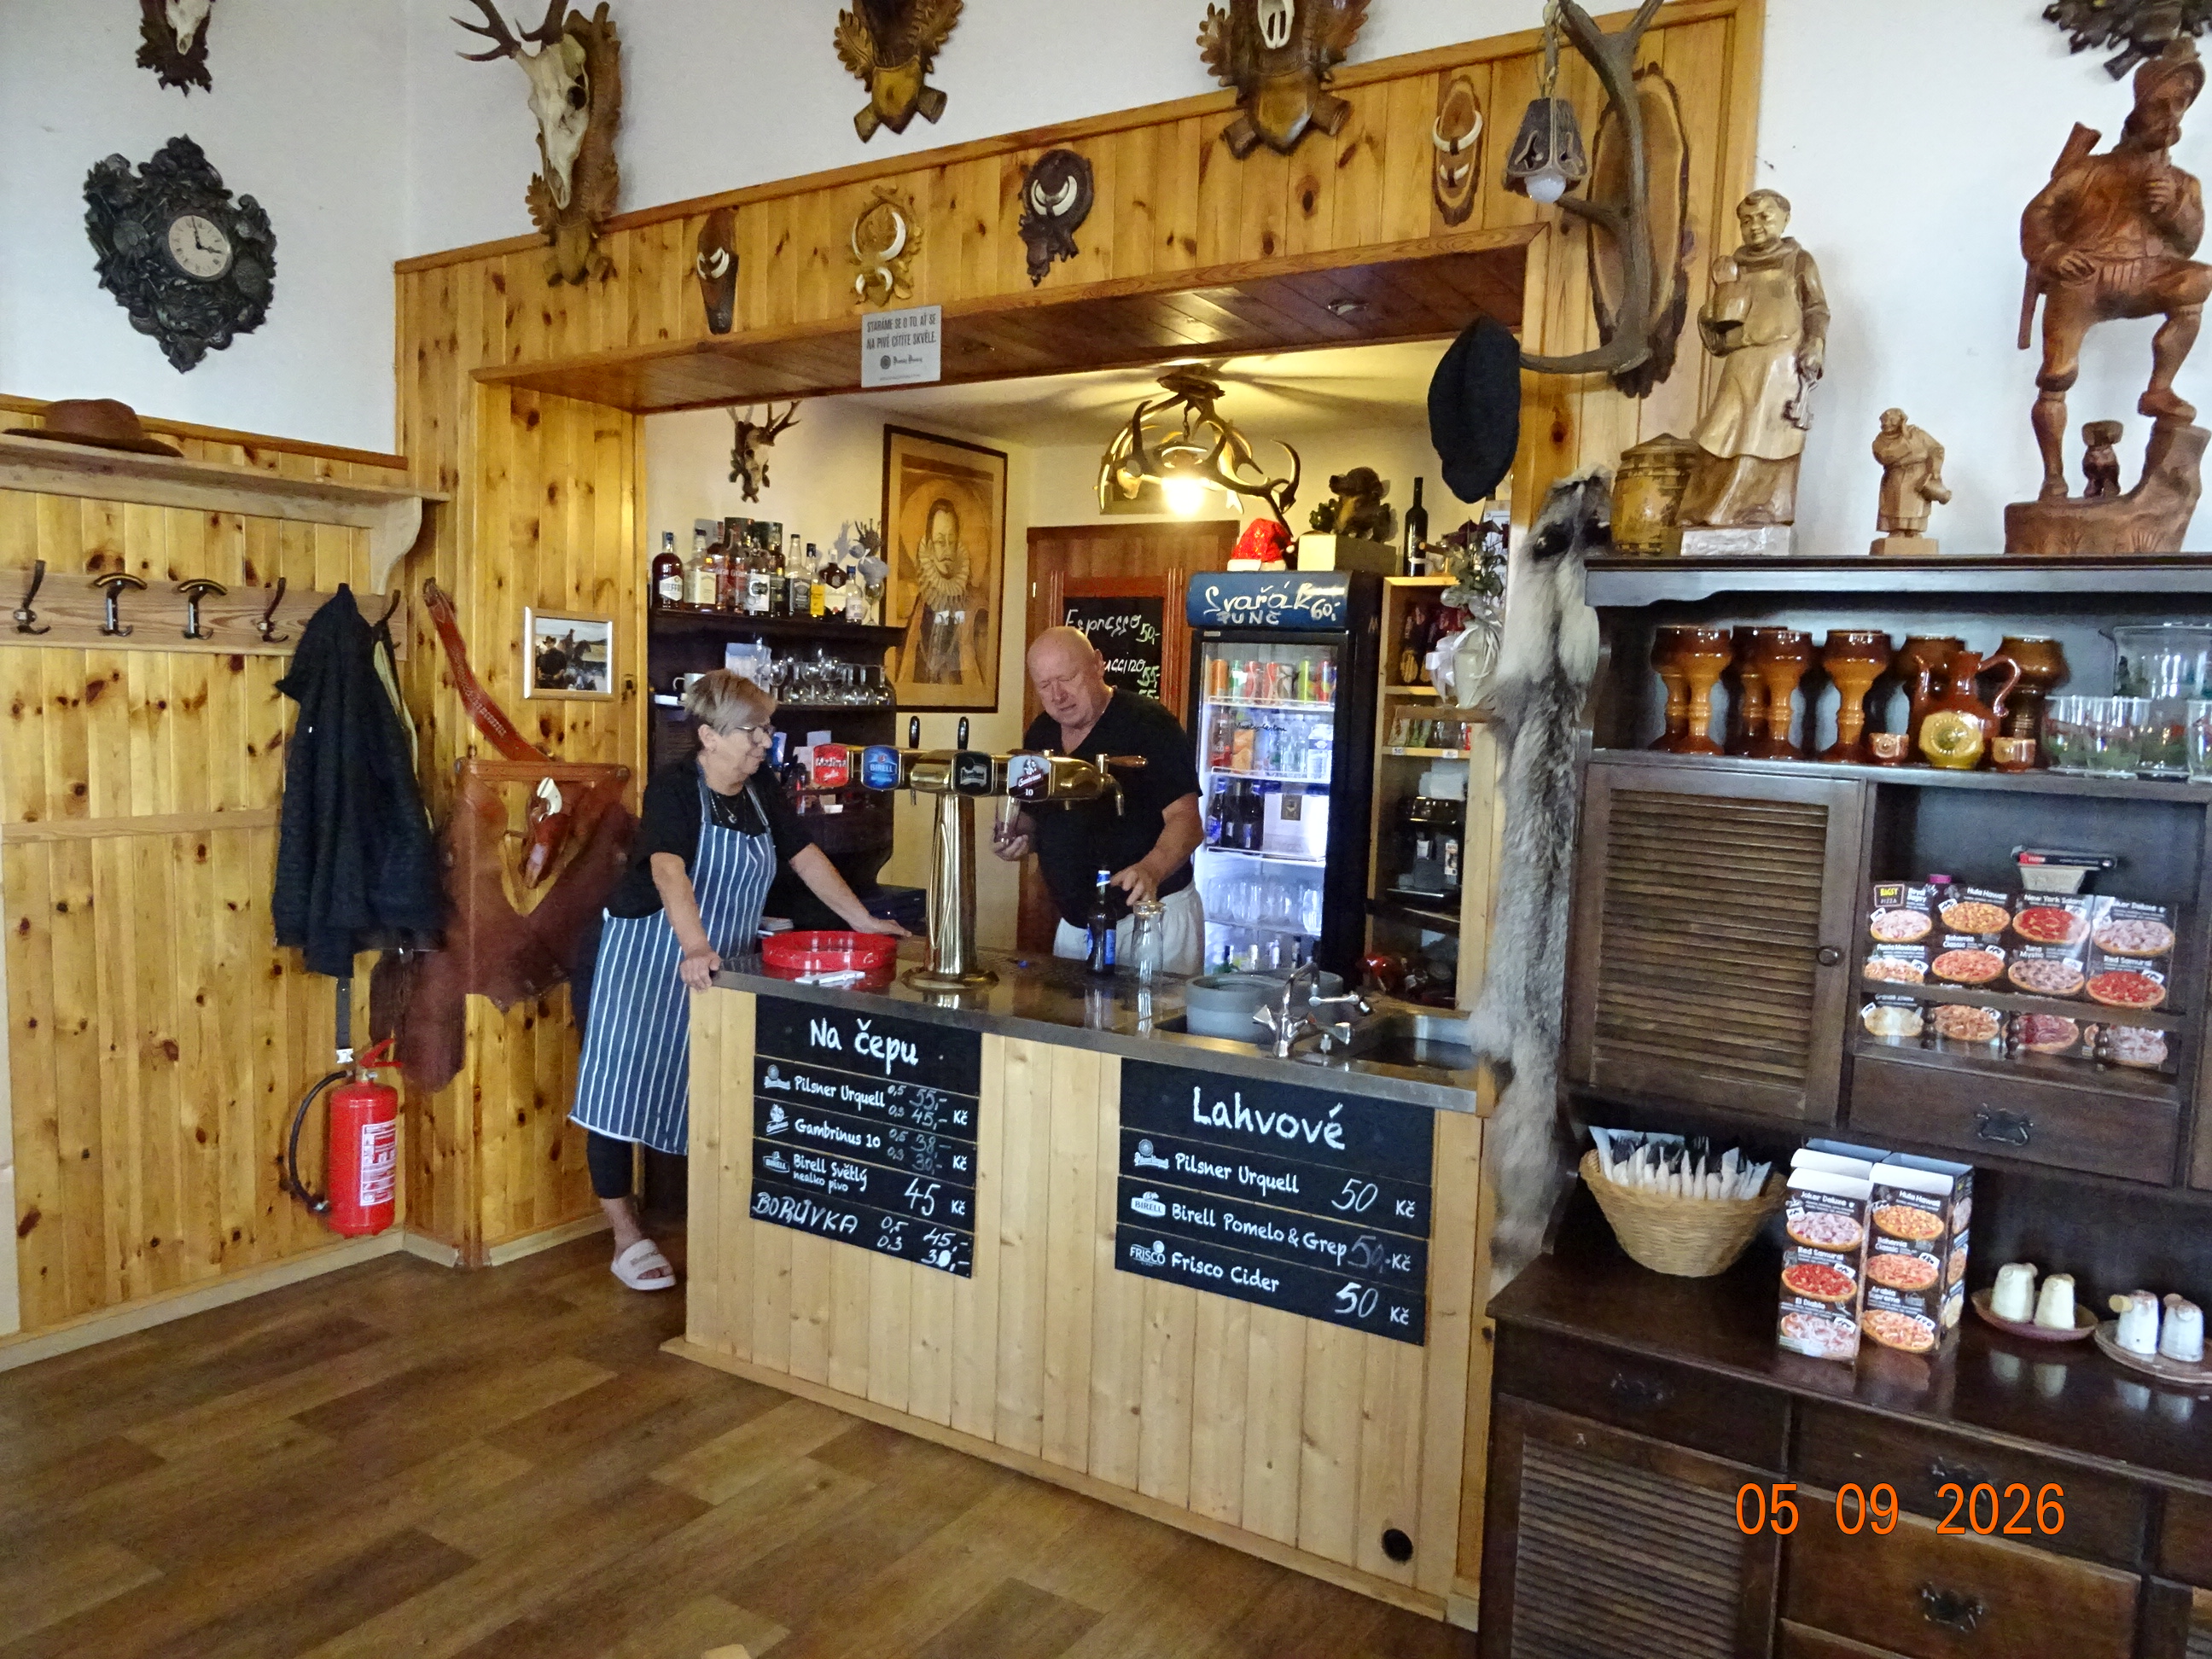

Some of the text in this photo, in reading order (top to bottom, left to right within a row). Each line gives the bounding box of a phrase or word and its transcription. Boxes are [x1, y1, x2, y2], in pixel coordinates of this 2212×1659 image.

[894, 317, 901, 329] SE
[929, 313, 936, 325] SE
[866, 337, 875, 350] NA
[1203, 581, 1313, 615] Svařák
[1065, 608, 1142, 638] Espresso
[870, 763, 893, 772] BIRELL
[811, 1018, 918, 1074] Na čepu
[795, 1075, 836, 1097] Pilsner
[841, 1085, 885, 1111] Urquell
[953, 1109, 968, 1126] Kč
[1194, 1086, 1345, 1150] Lahvové
[795, 1119, 861, 1145] Gambrinus
[866, 1133, 880, 1148] 10
[794, 1154, 867, 1190] Birell Světlý
[952, 1155, 967, 1171] Kč
[1175, 1152, 1231, 1179] Pilsner
[1238, 1166, 1300, 1196] Urquell
[794, 1168, 848, 1194] nealko pivo
[904, 1178, 940, 1216] 45
[951, 1199, 965, 1215] Kč
[1135, 1200, 1161, 1212] BIRELL
[1331, 1178, 1378, 1212] 50
[1899, 1190, 1915, 1201] Hula
[1395, 1199, 1414, 1219] Kč
[1173, 1203, 1347, 1266] Birell Pomelo & Grep
[1130, 1245, 1166, 1265] FRISCO
[1392, 1252, 1411, 1272] Kč
[1172, 1253, 1279, 1293] Frisco Cider
[1335, 1282, 1378, 1318] 50
[1390, 1306, 1409, 1325] Kč
